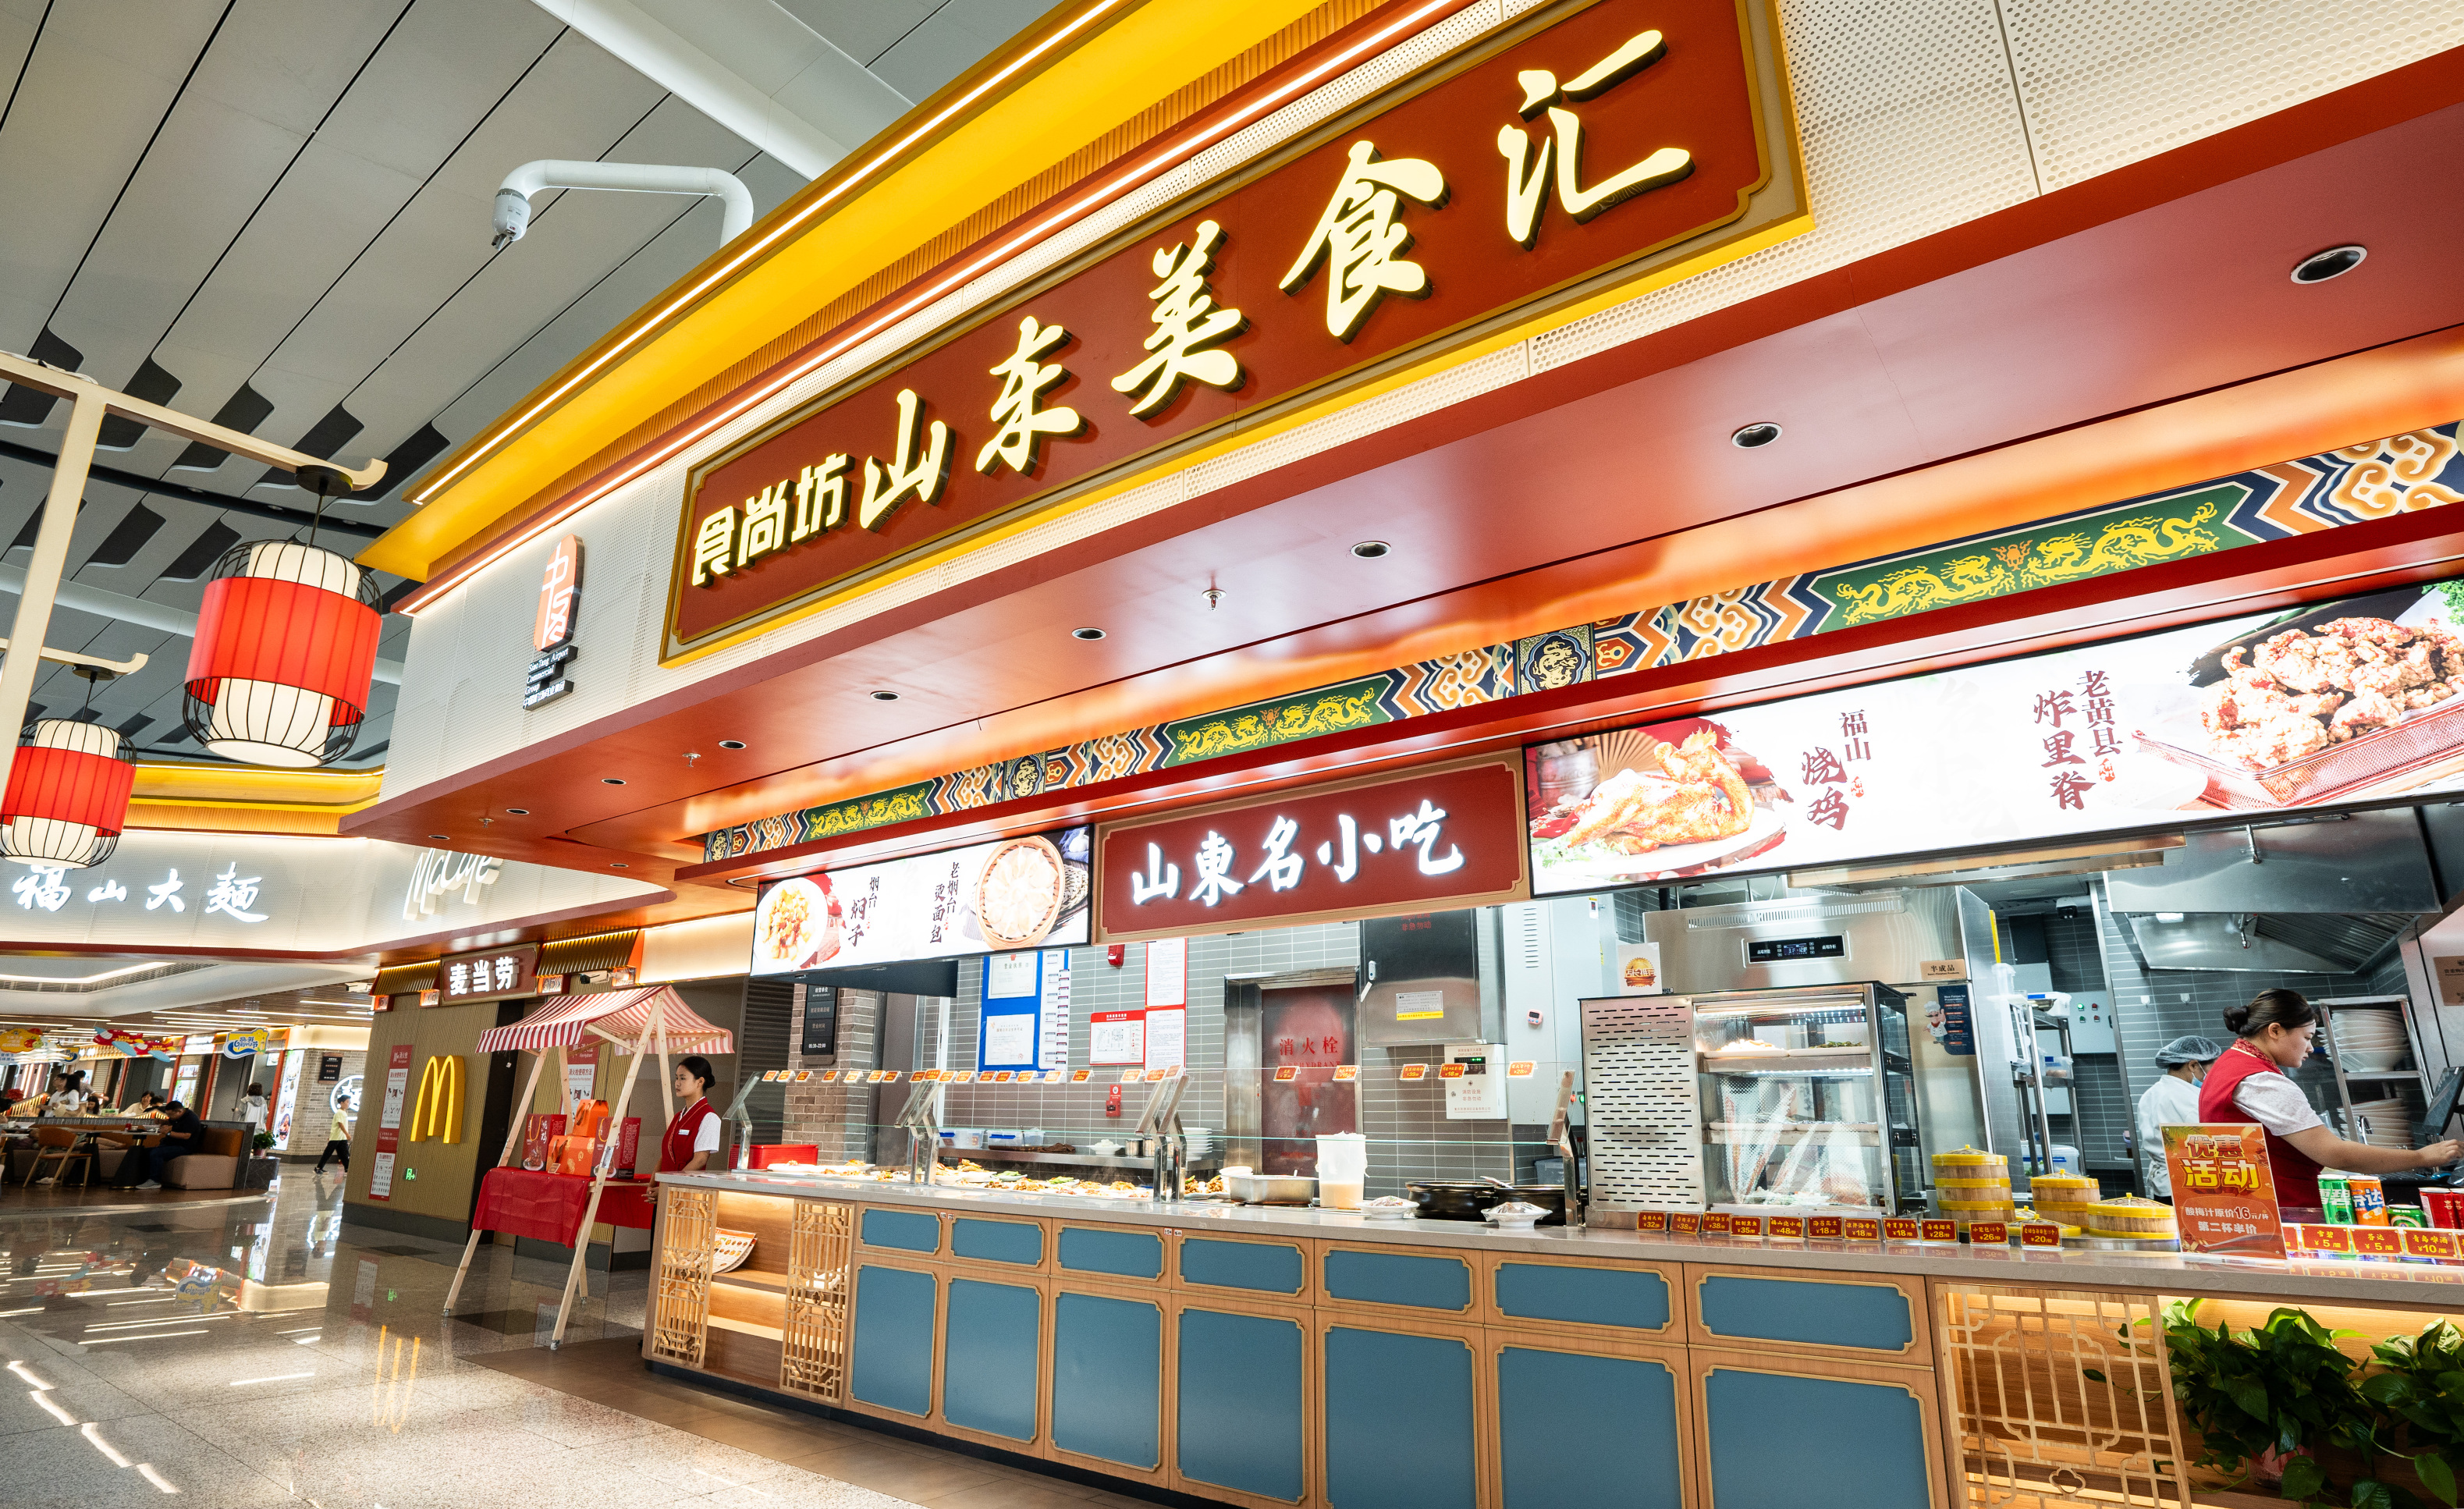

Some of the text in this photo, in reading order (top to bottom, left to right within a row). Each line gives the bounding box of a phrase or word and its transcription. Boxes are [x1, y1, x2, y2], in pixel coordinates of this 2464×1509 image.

[691, 453, 850, 587] 食尚坊
[551, 648, 569, 662] Airport
[525, 683, 540, 694] Group
[527, 664, 555, 683] Commercial
[2076, 670, 2124, 757] 老黄县
[1839, 709, 1871, 762] 福山
[2033, 690, 2097, 810] 炸里脊
[1801, 746, 1849, 831] 烧鸡
[1132, 799, 1466, 907] 山東名小吃
[868, 876, 879, 908] 烟台
[947, 862, 959, 914] 老烟台
[848, 897, 867, 947] 焖子
[929, 883, 946, 943] 烫面包
[1402, 921, 1432, 931] 非急勿动
[449, 955, 515, 996] 麦当劳
[1280, 1036, 1338, 1056] 消火栓
[2185, 1134, 2244, 1158] 优惠
[2182, 1158, 2260, 1190] 活动
[2185, 1206, 2269, 1220] 酸梅汁原价16元/杯
[2197, 1221, 2257, 1235] 第二杯半价
[2317, 1230, 2334, 1238] 雪碧
[2413, 1234, 2448, 1244] 青岛啤酒
